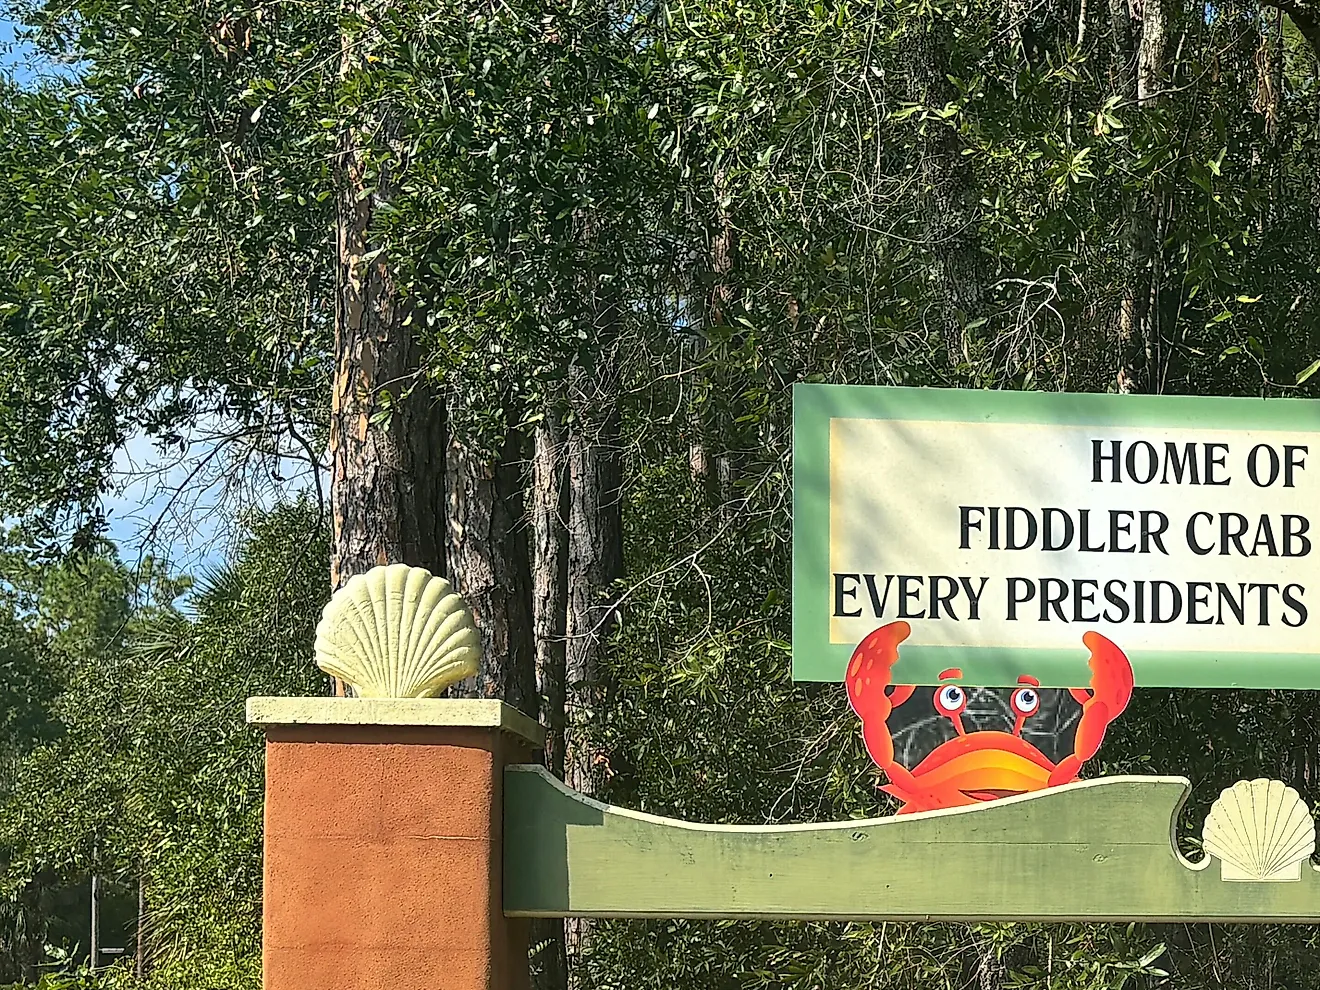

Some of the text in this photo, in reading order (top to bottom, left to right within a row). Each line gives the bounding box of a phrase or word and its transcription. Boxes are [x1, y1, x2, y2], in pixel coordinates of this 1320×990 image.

[1090, 439, 1232, 486] HOME
[1246, 443, 1309, 488] OF
[958, 505, 1170, 556] FIDDLER
[1185, 511, 1312, 558] CRAB
[832, 573, 990, 622] EVERY
[1005, 577, 1308, 628] PRESIDENTS
